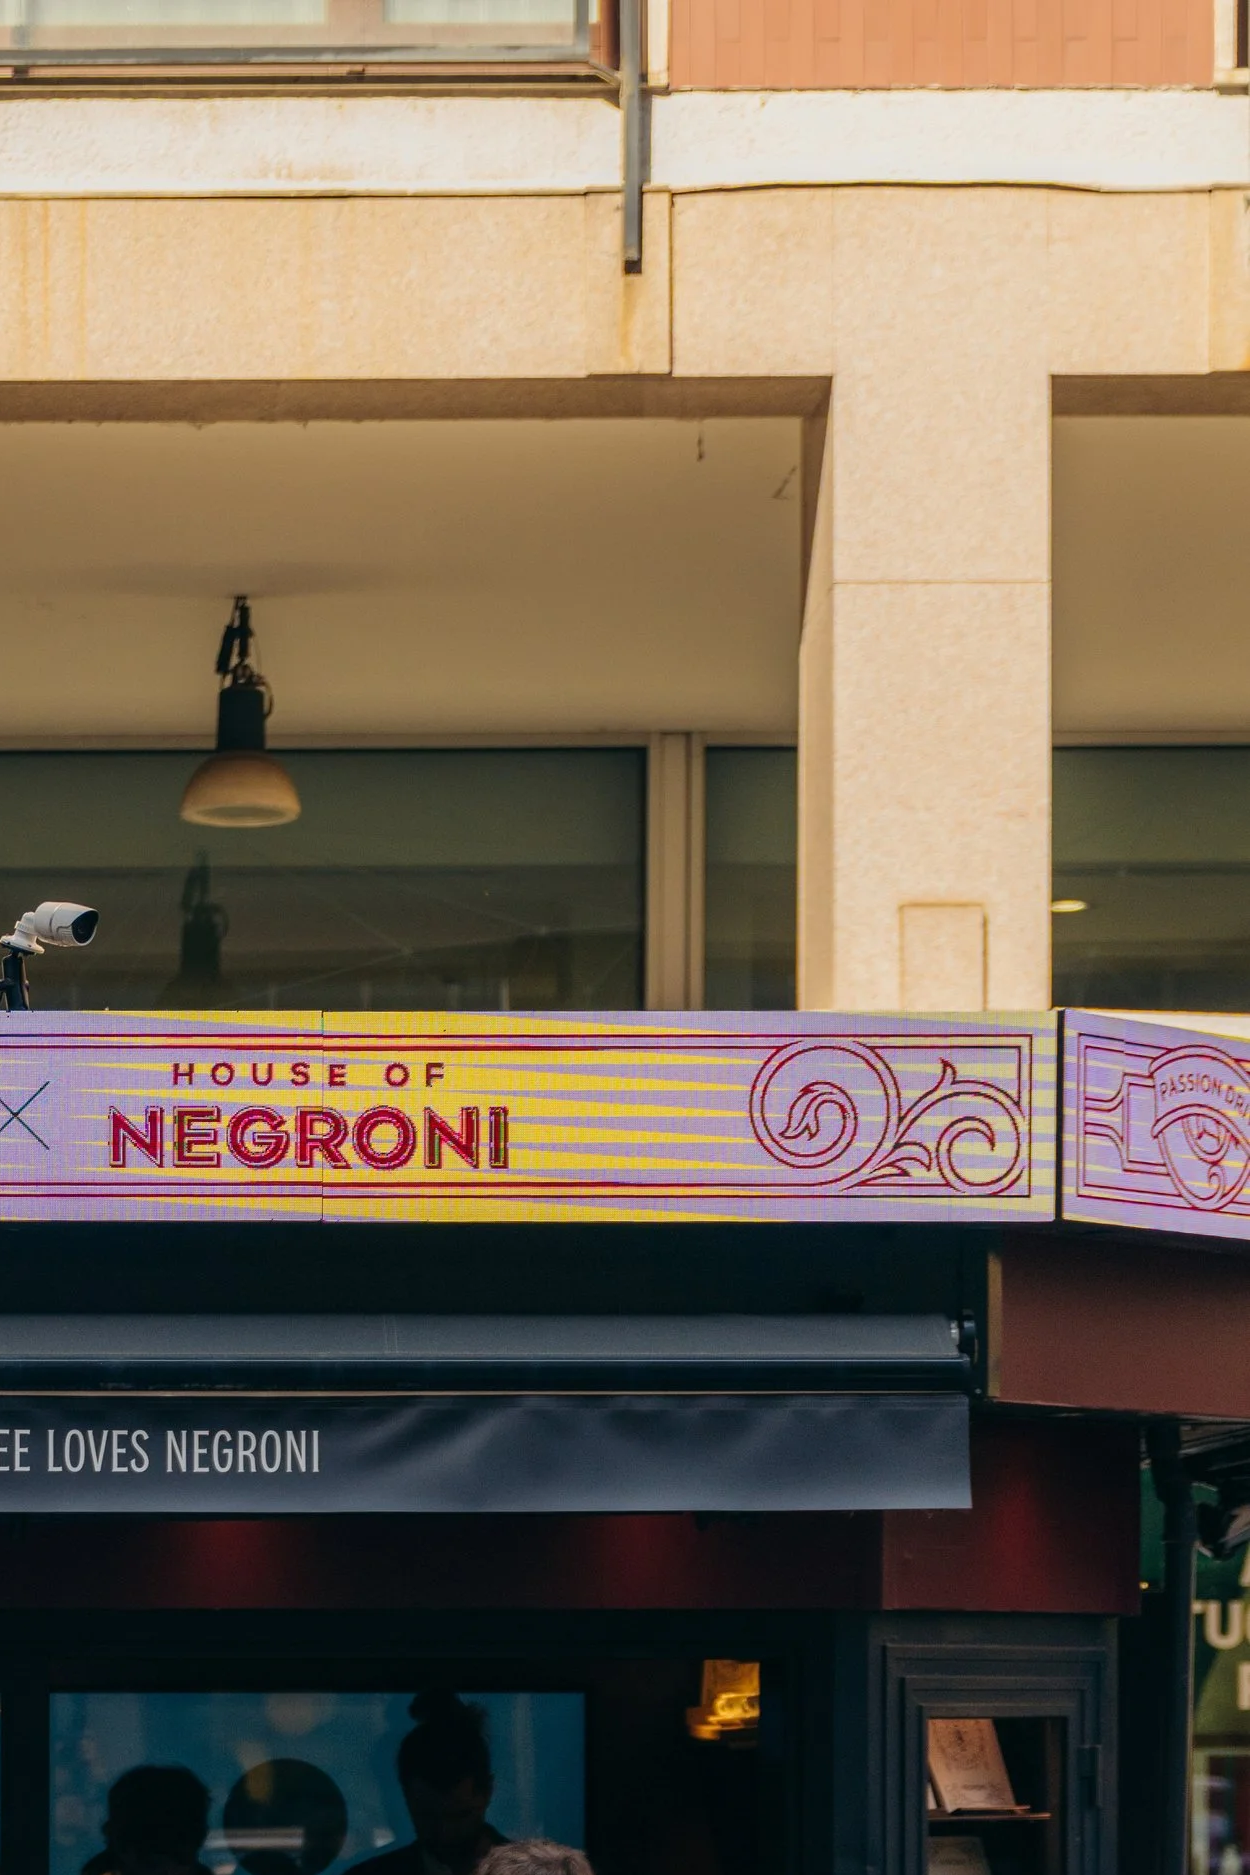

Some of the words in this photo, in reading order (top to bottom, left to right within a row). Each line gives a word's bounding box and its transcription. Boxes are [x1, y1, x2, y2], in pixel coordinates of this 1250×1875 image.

[172, 1062, 347, 1087] HOUSE
[384, 1062, 444, 1087] OF
[1159, 1073, 1223, 1100] PASSION
[108, 1105, 510, 1171] NEGRONI
[47, 1429, 150, 1472] LOVES
[166, 1430, 320, 1473] NEGRONI
